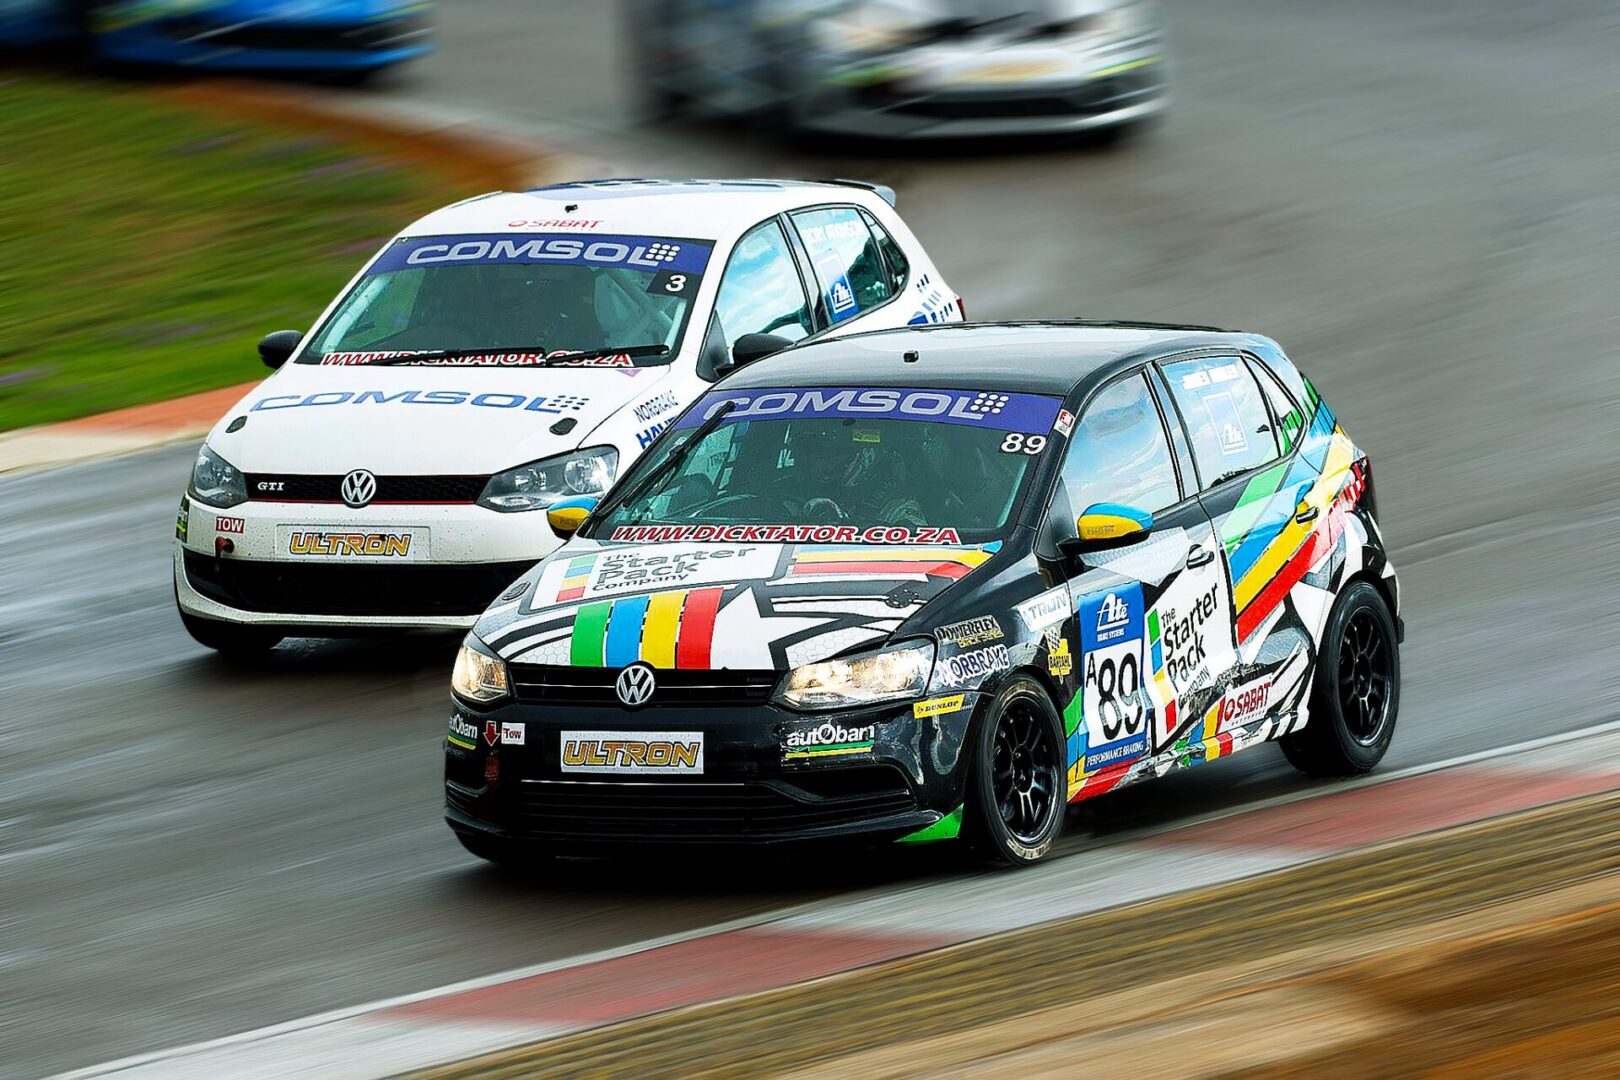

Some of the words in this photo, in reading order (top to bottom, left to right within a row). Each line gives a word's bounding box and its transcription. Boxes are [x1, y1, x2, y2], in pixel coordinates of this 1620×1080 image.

[406, 240, 660, 267] COMSOL
[665, 274, 687, 292] 3
[249, 390, 562, 414] COMSOL
[703, 390, 985, 420] COMSOL
[1000, 433, 1046, 455] 89
[257, 482, 285, 491] GTI
[217, 518, 243, 532] TOW
[611, 525, 962, 545] WWW.DICKTATOR.CO.ZA
[289, 532, 412, 556] ULTRON
[600, 547, 756, 572] Starter
[1161, 608, 1176, 628] The
[1164, 583, 1218, 661] Starter
[925, 701, 959, 712] DUNLOP
[1086, 652, 1097, 688] A
[1098, 652, 1142, 740] 89
[1234, 681, 1271, 719] SABAT
[562, 740, 700, 767] ULTRON
